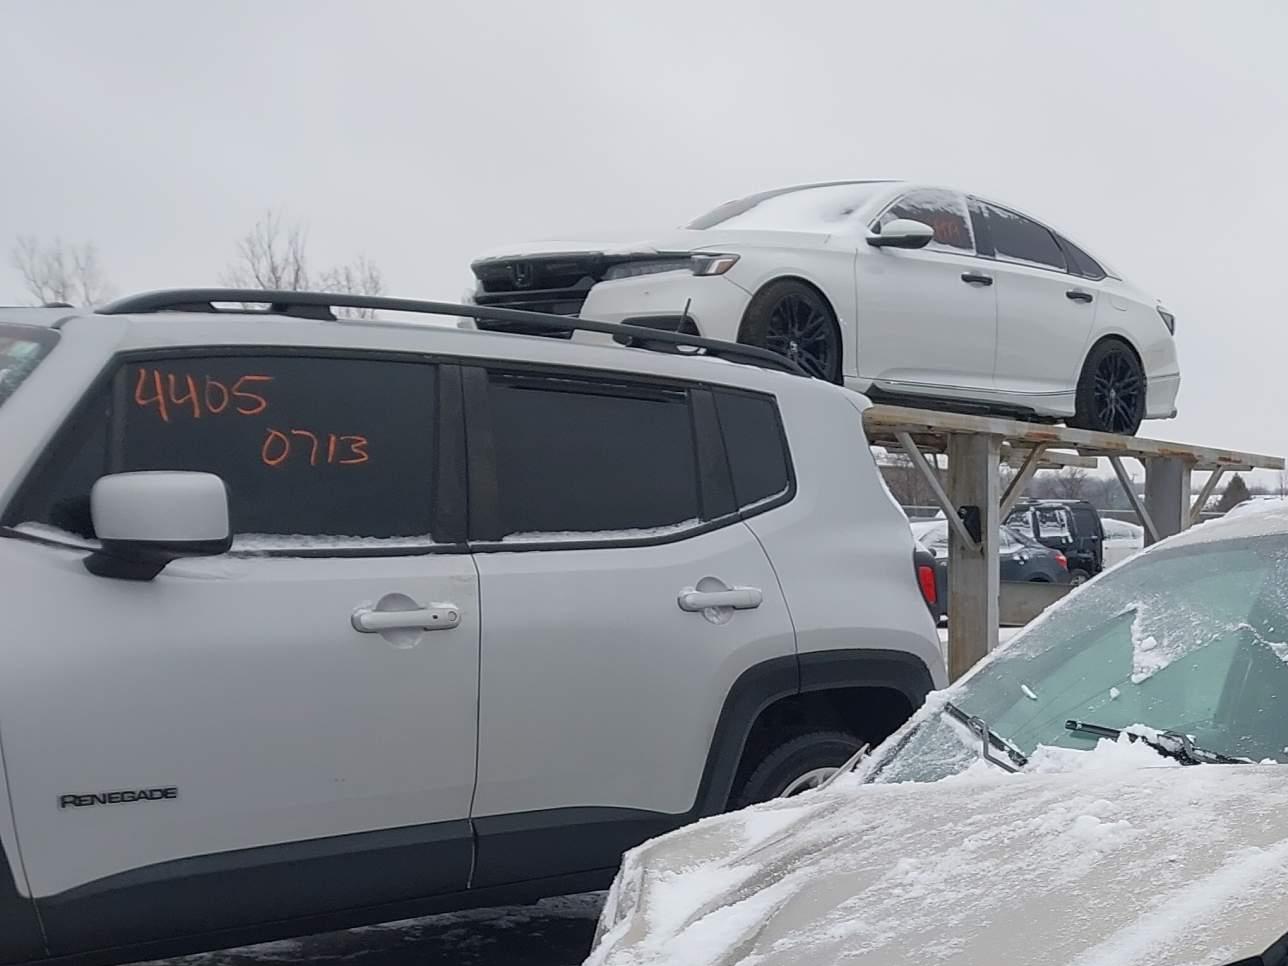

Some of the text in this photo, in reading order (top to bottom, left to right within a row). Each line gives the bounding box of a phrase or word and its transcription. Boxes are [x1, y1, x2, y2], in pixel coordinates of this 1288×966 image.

[135, 368, 273, 421] 4405
[261, 428, 370, 467] 0713
[61, 787, 178, 809] RENEGADE
